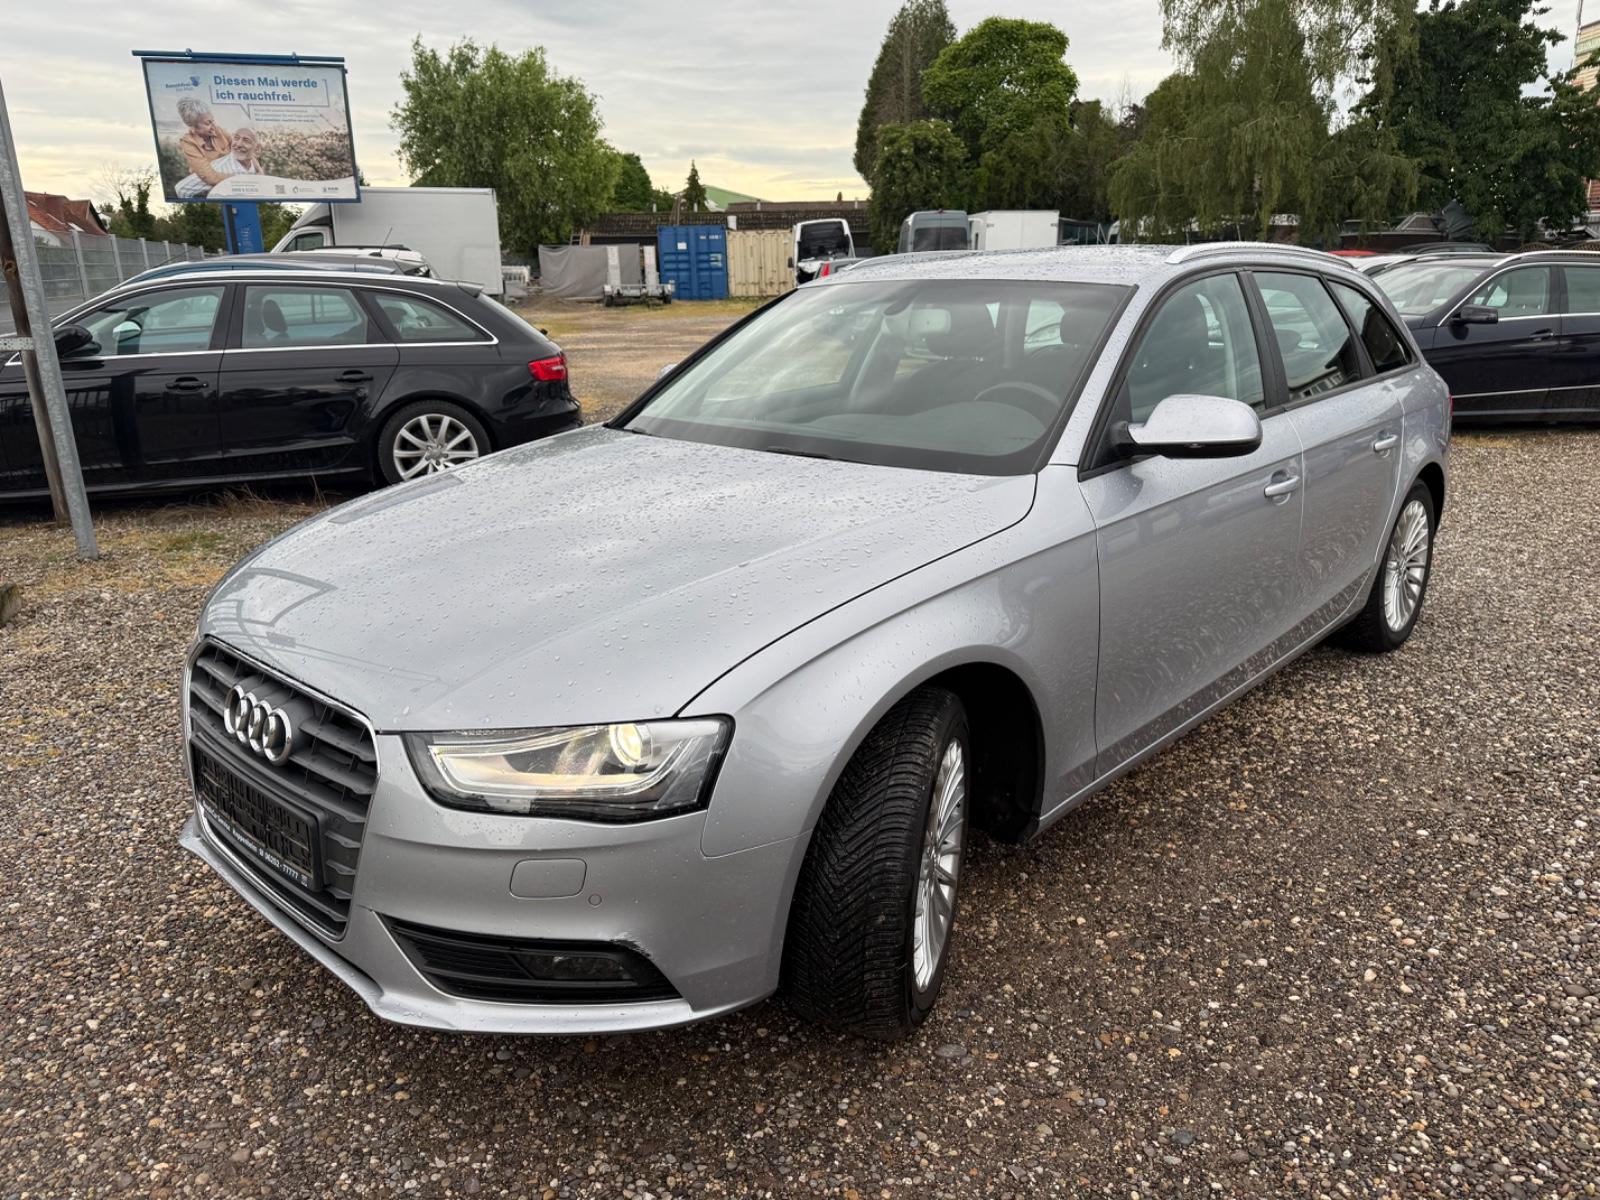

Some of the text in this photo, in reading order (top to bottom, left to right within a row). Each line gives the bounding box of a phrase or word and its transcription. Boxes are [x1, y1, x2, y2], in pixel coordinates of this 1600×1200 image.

[213, 75, 318, 88] Diesen Mai werde
[215, 89, 296, 102] ich rauchfrei.
